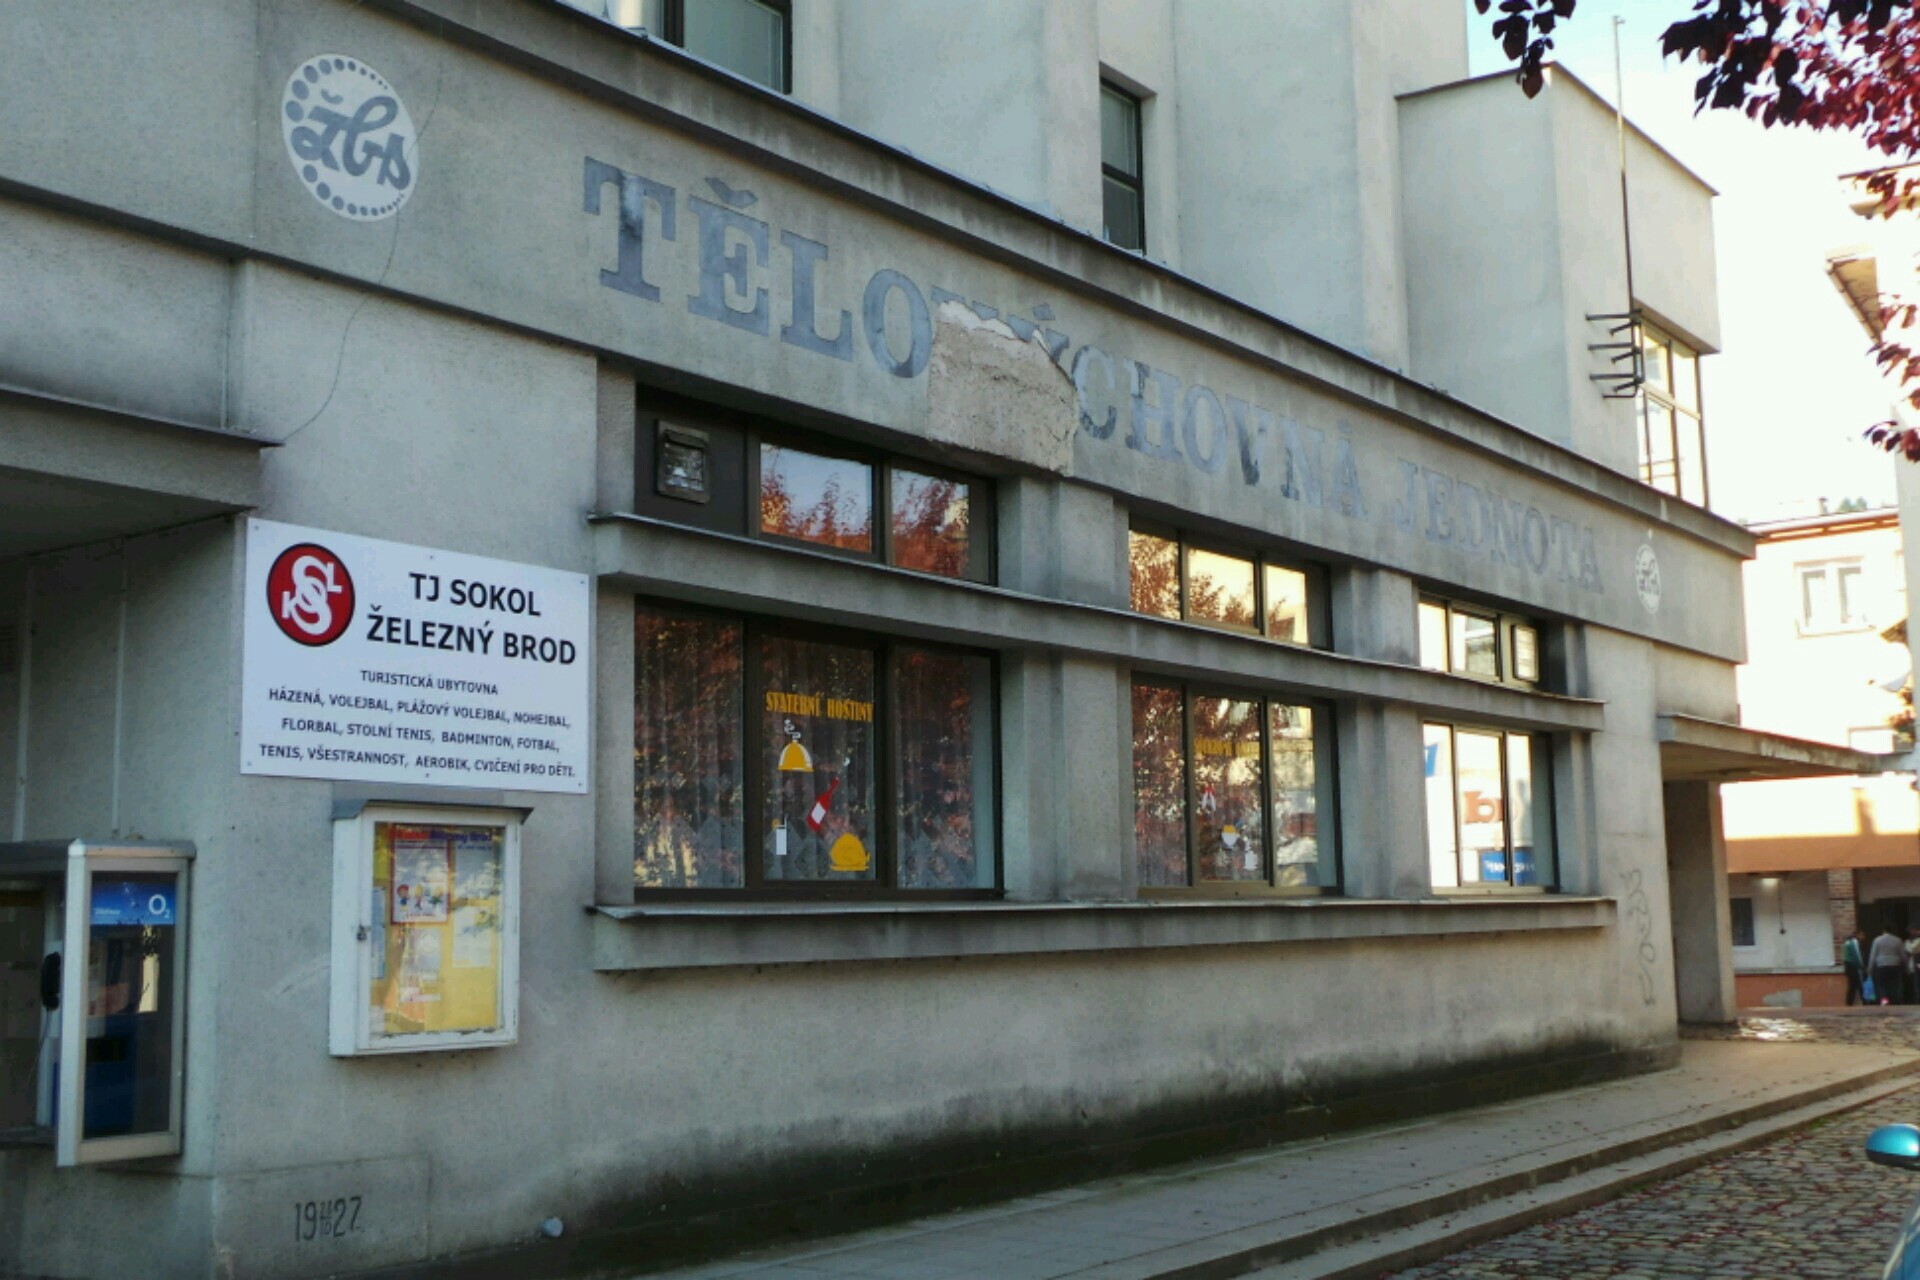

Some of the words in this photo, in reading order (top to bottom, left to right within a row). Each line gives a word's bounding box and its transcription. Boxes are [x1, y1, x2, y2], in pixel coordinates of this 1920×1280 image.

[583, 157, 1368, 520] TĚLOCHOVNÁ
[1397, 457, 1602, 595] JEDNOTA
[408, 571, 440, 602] TJ
[449, 578, 541, 617] SOKOL
[366, 603, 494, 655] ŽELEZNÝ
[502, 631, 576, 665] BROD
[360, 670, 434, 688] TURISTICKÁ
[437, 678, 499, 695] UBYTOVNA
[269, 686, 325, 707] HÁZENÁ,
[329, 694, 394, 713] VOLEJBAL,
[397, 699, 450, 716] PLÁŽOVÝ
[453, 706, 510, 724] VOLEJBAL,
[513, 711, 571, 729] NOHEJBAL,
[281, 717, 344, 737] FLORBAL,
[346, 721, 393, 739] STOLNÍ
[396, 727, 435, 744] TENIS,
[441, 731, 514, 749] BADMINTON,
[517, 737, 560, 753] FOTBAL,
[259, 743, 304, 762] TENIS,
[307, 744, 409, 768] VŠESTRANNOST,
[415, 755, 471, 772] AEROBIK,
[474, 758, 521, 774] CVIČENÍ
[523, 763, 546, 775] PRO
[549, 762, 576, 778] DĚTI.
